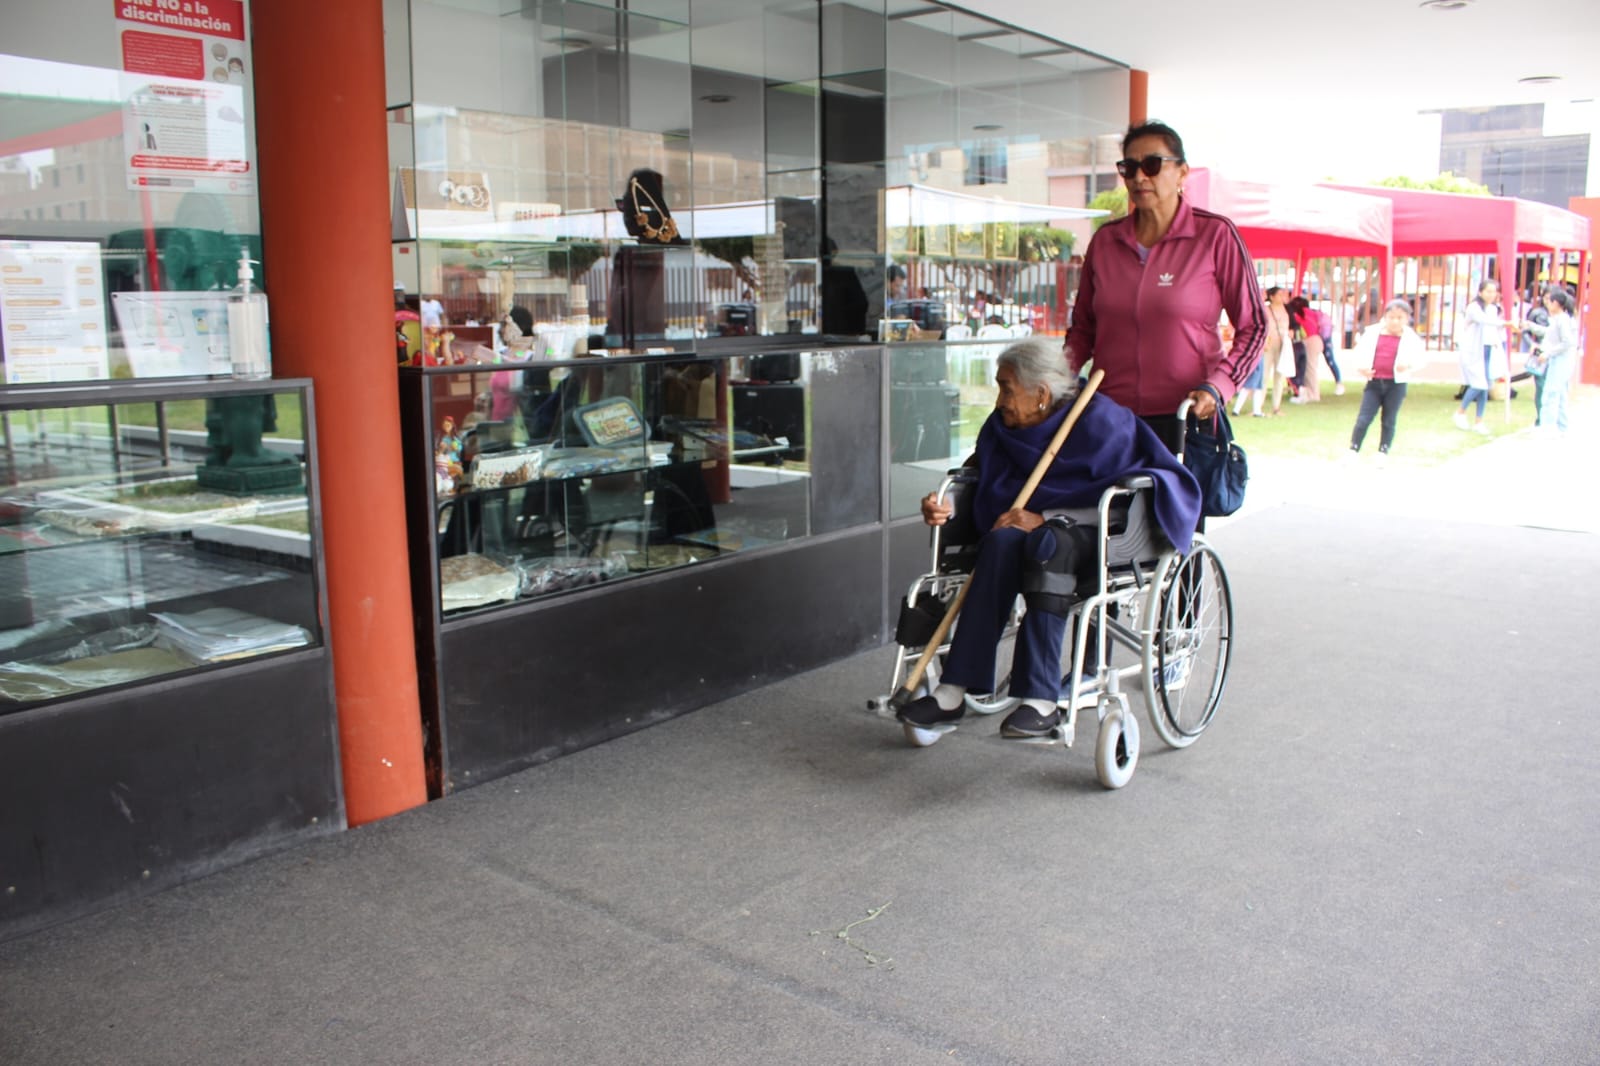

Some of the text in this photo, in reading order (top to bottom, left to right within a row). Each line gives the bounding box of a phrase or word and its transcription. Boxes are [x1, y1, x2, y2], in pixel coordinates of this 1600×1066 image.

[156, 0, 180, 10] NO
[183, 2, 192, 13] a
[195, 1, 209, 15] la
[122, 5, 231, 32] discriminación
